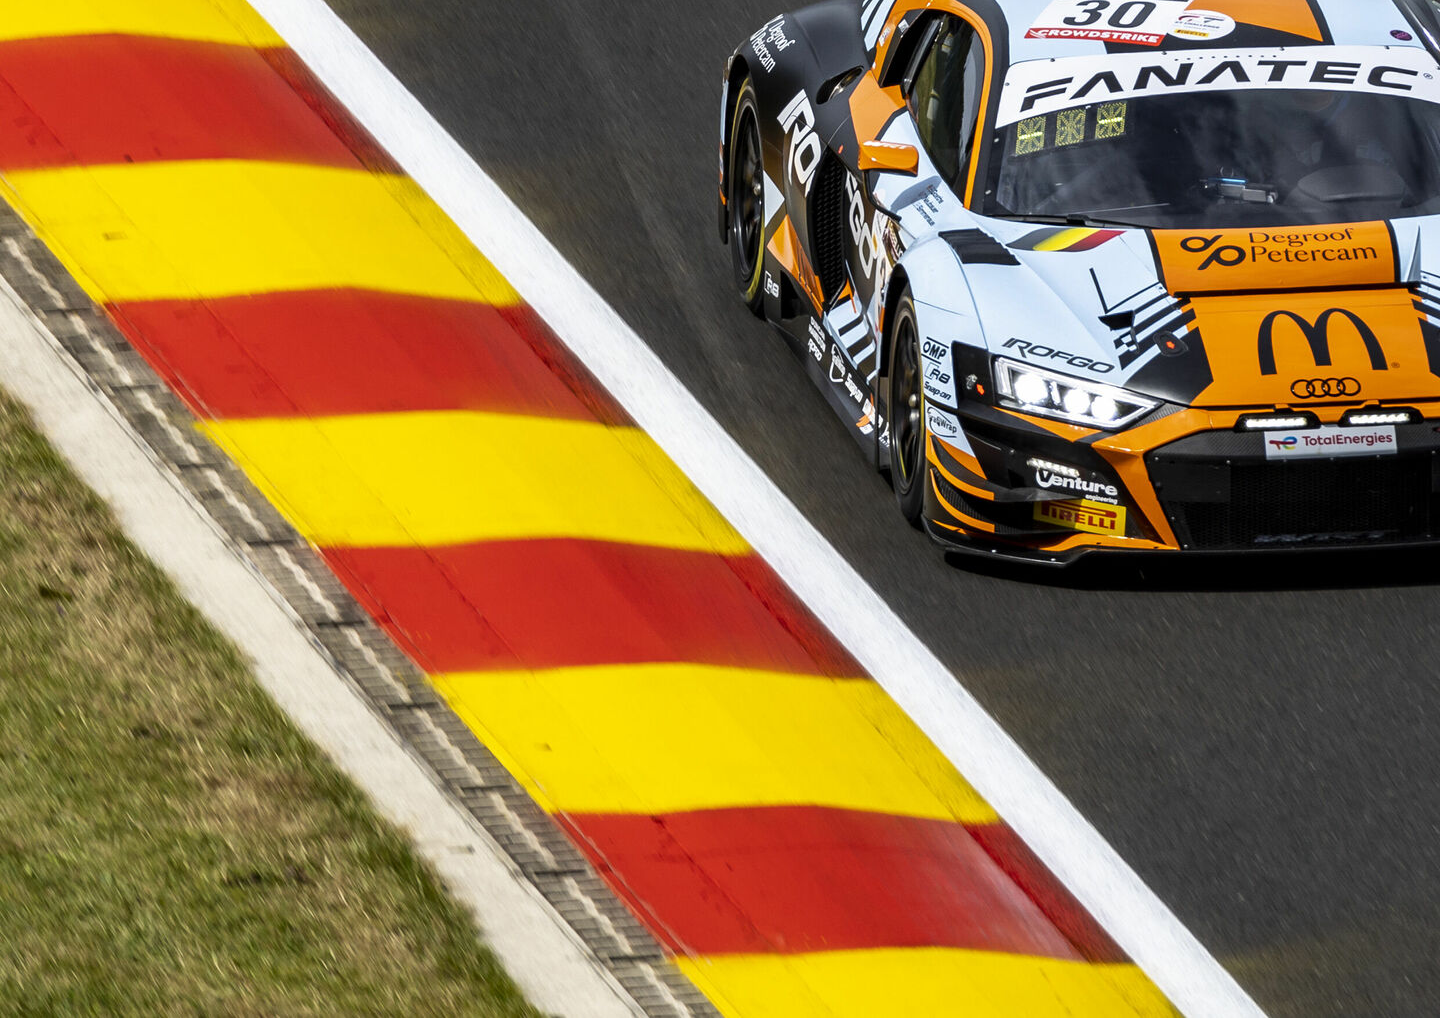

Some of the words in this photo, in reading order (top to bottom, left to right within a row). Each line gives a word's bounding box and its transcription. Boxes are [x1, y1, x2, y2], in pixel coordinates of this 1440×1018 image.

[1062, 0, 1157, 28] 30
[1036, 29, 1160, 44] CROWDSTRIKE
[1020, 60, 1418, 113] FANATEC
[1249, 228, 1354, 247] Degroof
[1251, 246, 1378, 263] Petercam
[922, 340, 947, 360] OMP
[1002, 337, 1115, 373] IROFGO
[929, 367, 951, 384] R8
[1301, 432, 1393, 447] TotalEnergies
[1035, 468, 1119, 496] Venture
[1041, 500, 1118, 530] PIRELLI
